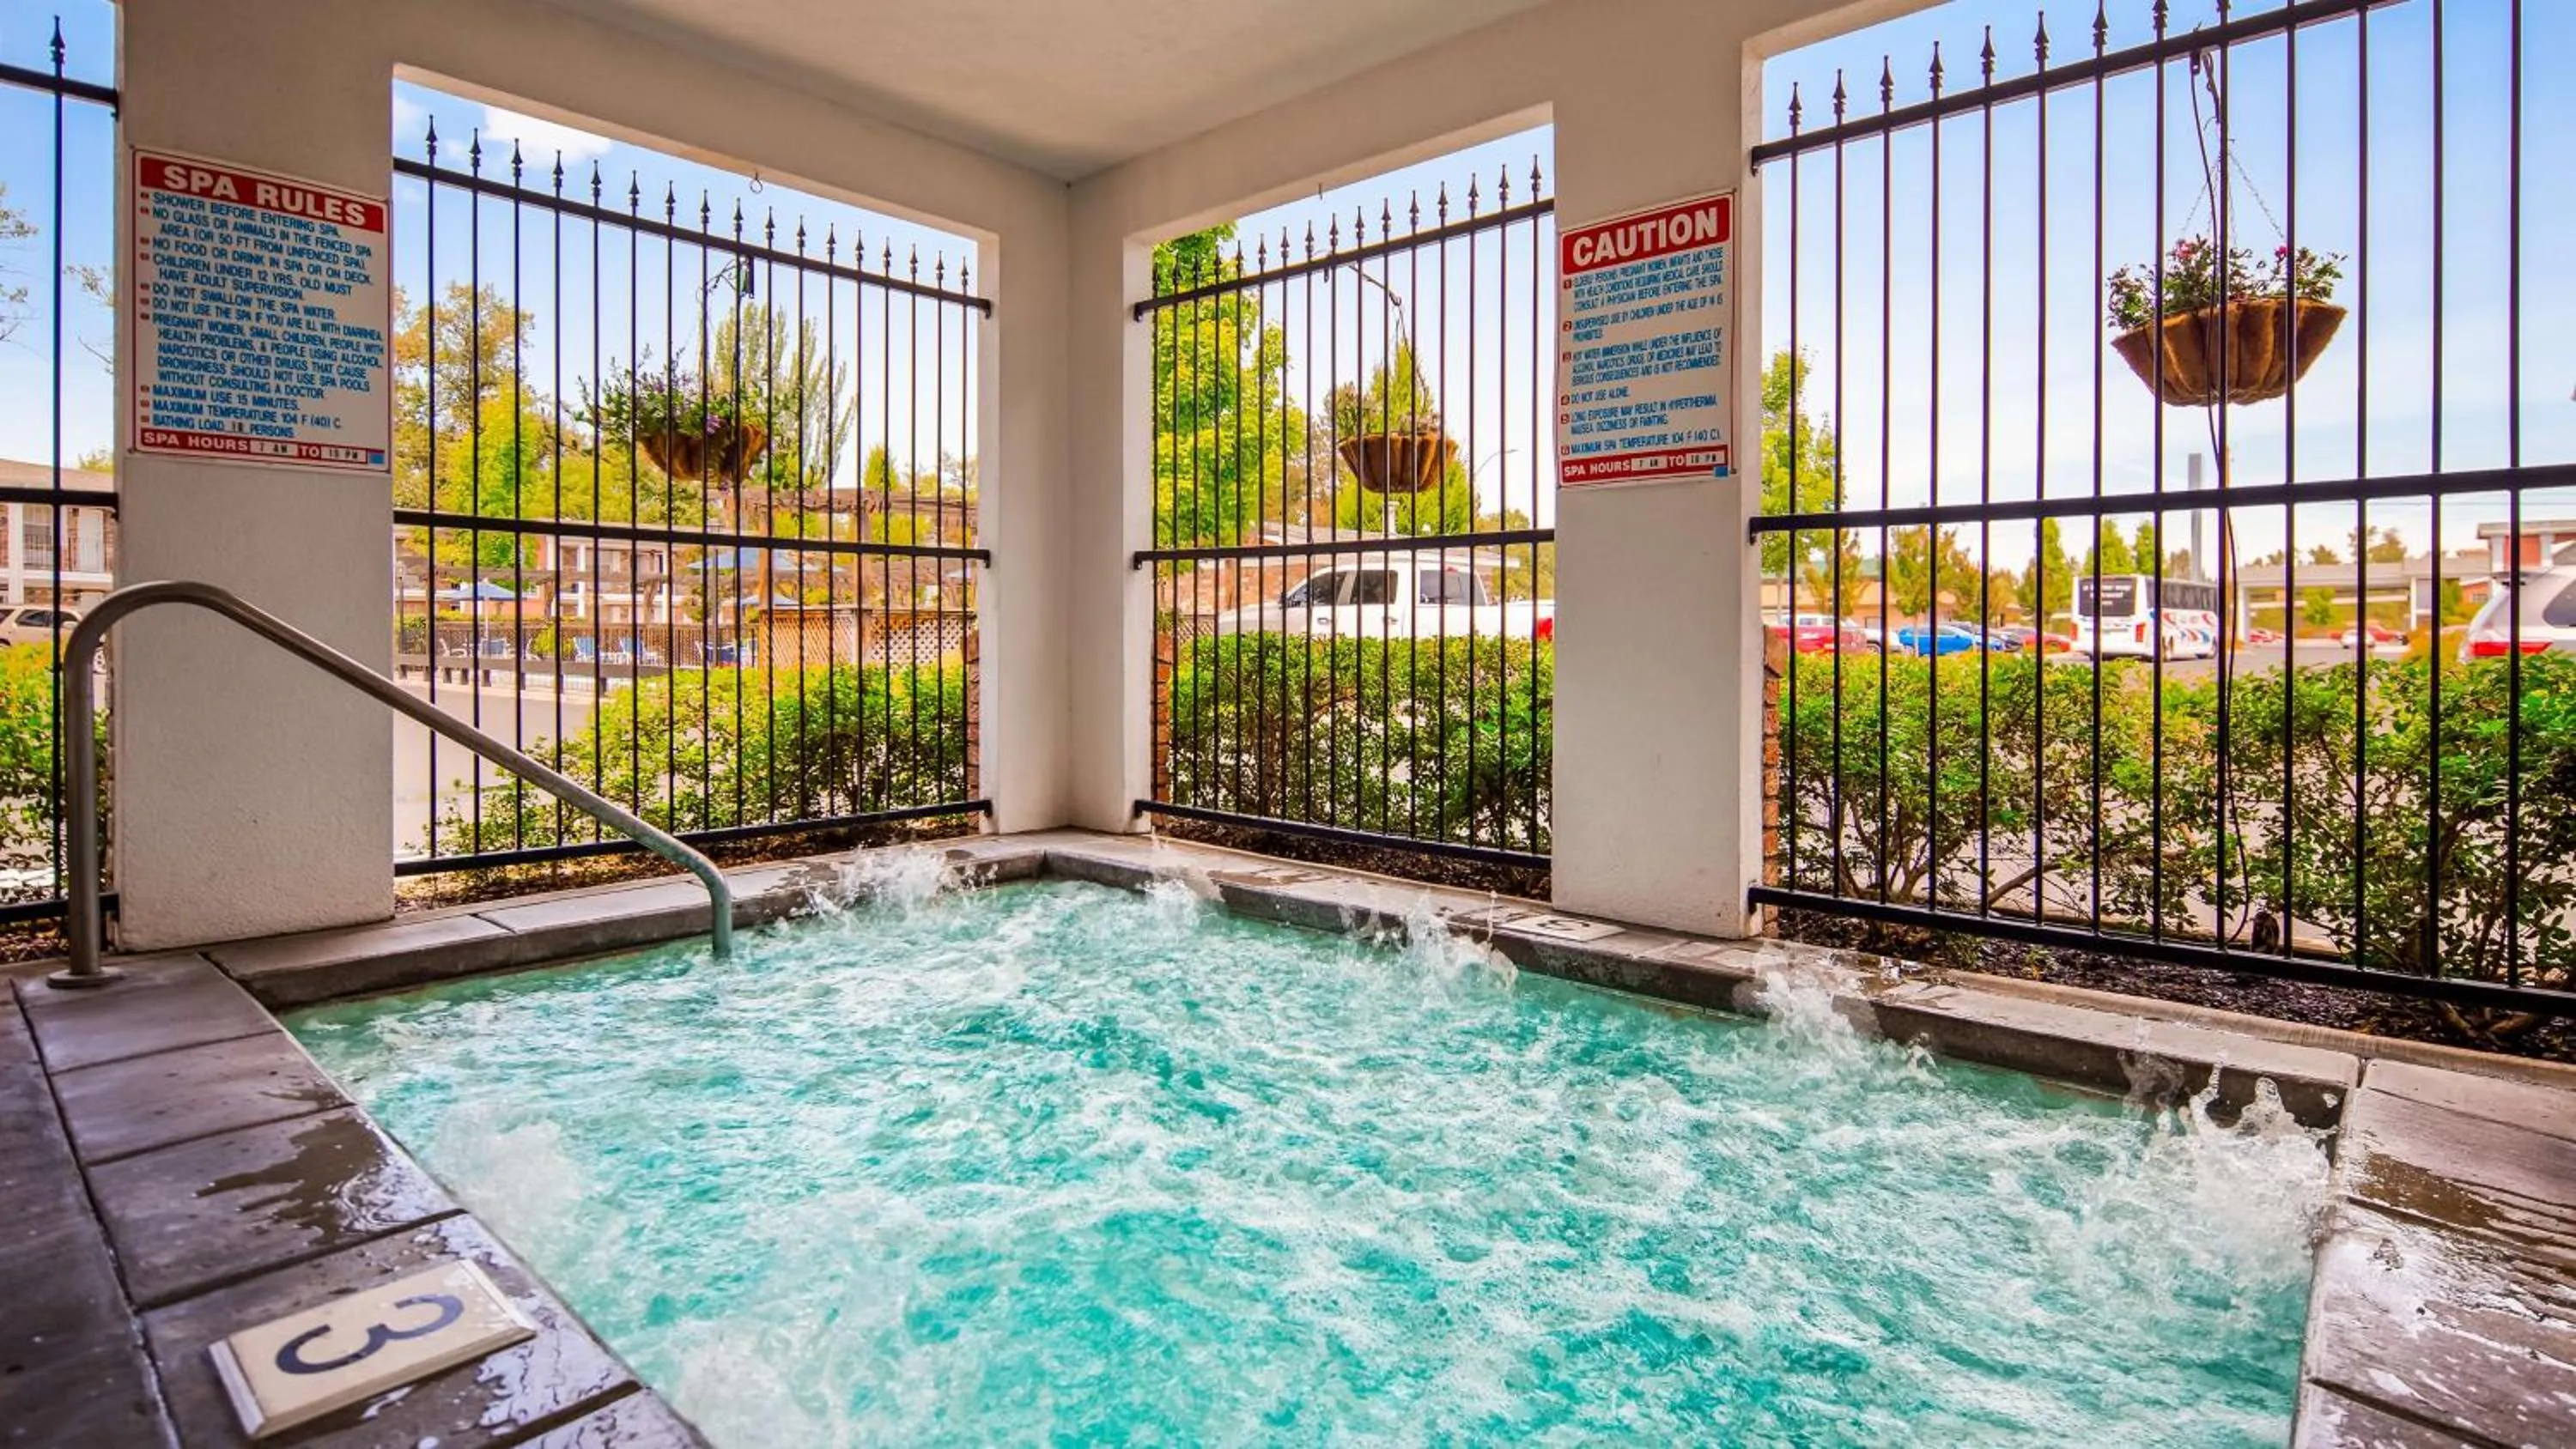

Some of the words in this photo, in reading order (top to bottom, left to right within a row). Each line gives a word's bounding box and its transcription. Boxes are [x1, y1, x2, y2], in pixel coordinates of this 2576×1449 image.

[154, 191, 204, 211] SHOWER
[210, 203, 255, 221] BEFORE
[261, 212, 314, 232] ENTERING
[163, 165, 239, 200] SPA
[257, 183, 366, 226] RULES
[153, 206, 168, 220] NO
[173, 210, 209, 227] GLASS
[213, 217, 228, 231] OR
[233, 221, 275, 239] ANIMALS
[280, 230, 289, 241] IN
[294, 233, 311, 246] THE
[316, 237, 351, 253] FENCED
[355, 244, 371, 257] SPA
[160, 221, 189, 238] AREA
[194, 228, 213, 242] (OR
[218, 233, 232, 246] 50
[236, 236, 248, 249] FT
[254, 239, 283, 255] FROM
[288, 245, 338, 264] UNFENCED
[1572, 207, 1717, 267] CAUTION
[153, 236, 169, 250] NO
[175, 240, 206, 256] FOOD
[212, 246, 227, 260] OR
[232, 250, 264, 266] DRINK
[270, 257, 279, 269] IN
[284, 259, 302, 273] SPA
[307, 264, 321, 276] OR
[326, 267, 340, 279] ON
[153, 252, 210, 272] CHILDREN
[215, 263, 252, 280] UNDER
[258, 270, 268, 282] 12
[300, 277, 319, 291] OLD
[325, 282, 351, 296] MUST
[159, 267, 187, 282] HAVE
[193, 273, 226, 288] ADULT
[1637, 286, 1659, 299] BEFORE
[153, 282, 168, 294] DO
[173, 285, 195, 299] NOT
[201, 289, 252, 307] SWALLOW
[258, 299, 275, 311] THE
[281, 302, 298, 315] SPA
[153, 297, 167, 309] DO
[171, 300, 188, 312] NOT
[194, 303, 211, 316] USE
[216, 306, 230, 318] THE
[236, 309, 250, 321] SPA
[265, 313, 283, 326] YOU
[287, 317, 301, 329] ARE
[306, 320, 317, 331] ILL
[321, 322, 340, 335] WITH
[154, 312, 204, 329] PREGNANT
[250, 326, 277, 340] SMALL
[330, 338, 360, 351] PEOPLE
[365, 343, 383, 355] WITH
[159, 327, 196, 343] HEALTH
[271, 343, 306, 357] PEOPLE
[310, 349, 337, 361] USING
[158, 342, 216, 360] NARCOTICS
[221, 350, 235, 362] OR
[240, 353, 270, 367] OTHER
[275, 357, 307, 372] DRUGS
[313, 362, 332, 374] THAT
[337, 366, 366, 379] CAUSE
[158, 355, 224, 373] DROWSINESS
[231, 365, 270, 379] SHOULD
[275, 371, 293, 382] NOT
[297, 373, 314, 385] USE
[320, 377, 336, 387] SPA
[154, 384, 205, 400] MAXIMUM
[211, 391, 231, 403] USE
[237, 394, 247, 404] 15
[252, 396, 300, 410] MINUTES.
[158, 369, 204, 385] WITHOUT
[210, 375, 270, 392] CONSULTING
[275, 384, 281, 394] A
[1572, 393, 1579, 403] DO
[1582, 391, 1592, 402] NOT
[1595, 390, 1606, 400] USE
[154, 398, 203, 414] MAXIMUM
[208, 405, 276, 421] TEMPERATURE
[282, 413, 296, 424] 104
[302, 415, 307, 425] F
[154, 414, 194, 427] BATHING
[198, 418, 223, 430] LOAD
[1589, 407, 1618, 420] EXPOSURE
[1621, 405, 1631, 416] MAY
[1635, 403, 1656, 415] RESULT
[143, 431, 179, 445] SPA
[188, 435, 247, 451] HOURS
[273, 444, 287, 455] AM
[301, 446, 319, 458] TO
[1571, 441, 1601, 453] MAXIMUM
[1604, 440, 1616, 450] SPA
[1619, 434, 1668, 448] TEMPERATURE
[1673, 433, 1683, 443] 104
[1564, 464, 1585, 476] SPA
[1589, 460, 1630, 474] HOURS
[1669, 455, 1684, 466] TO
[275, 1294, 465, 1374] 3
